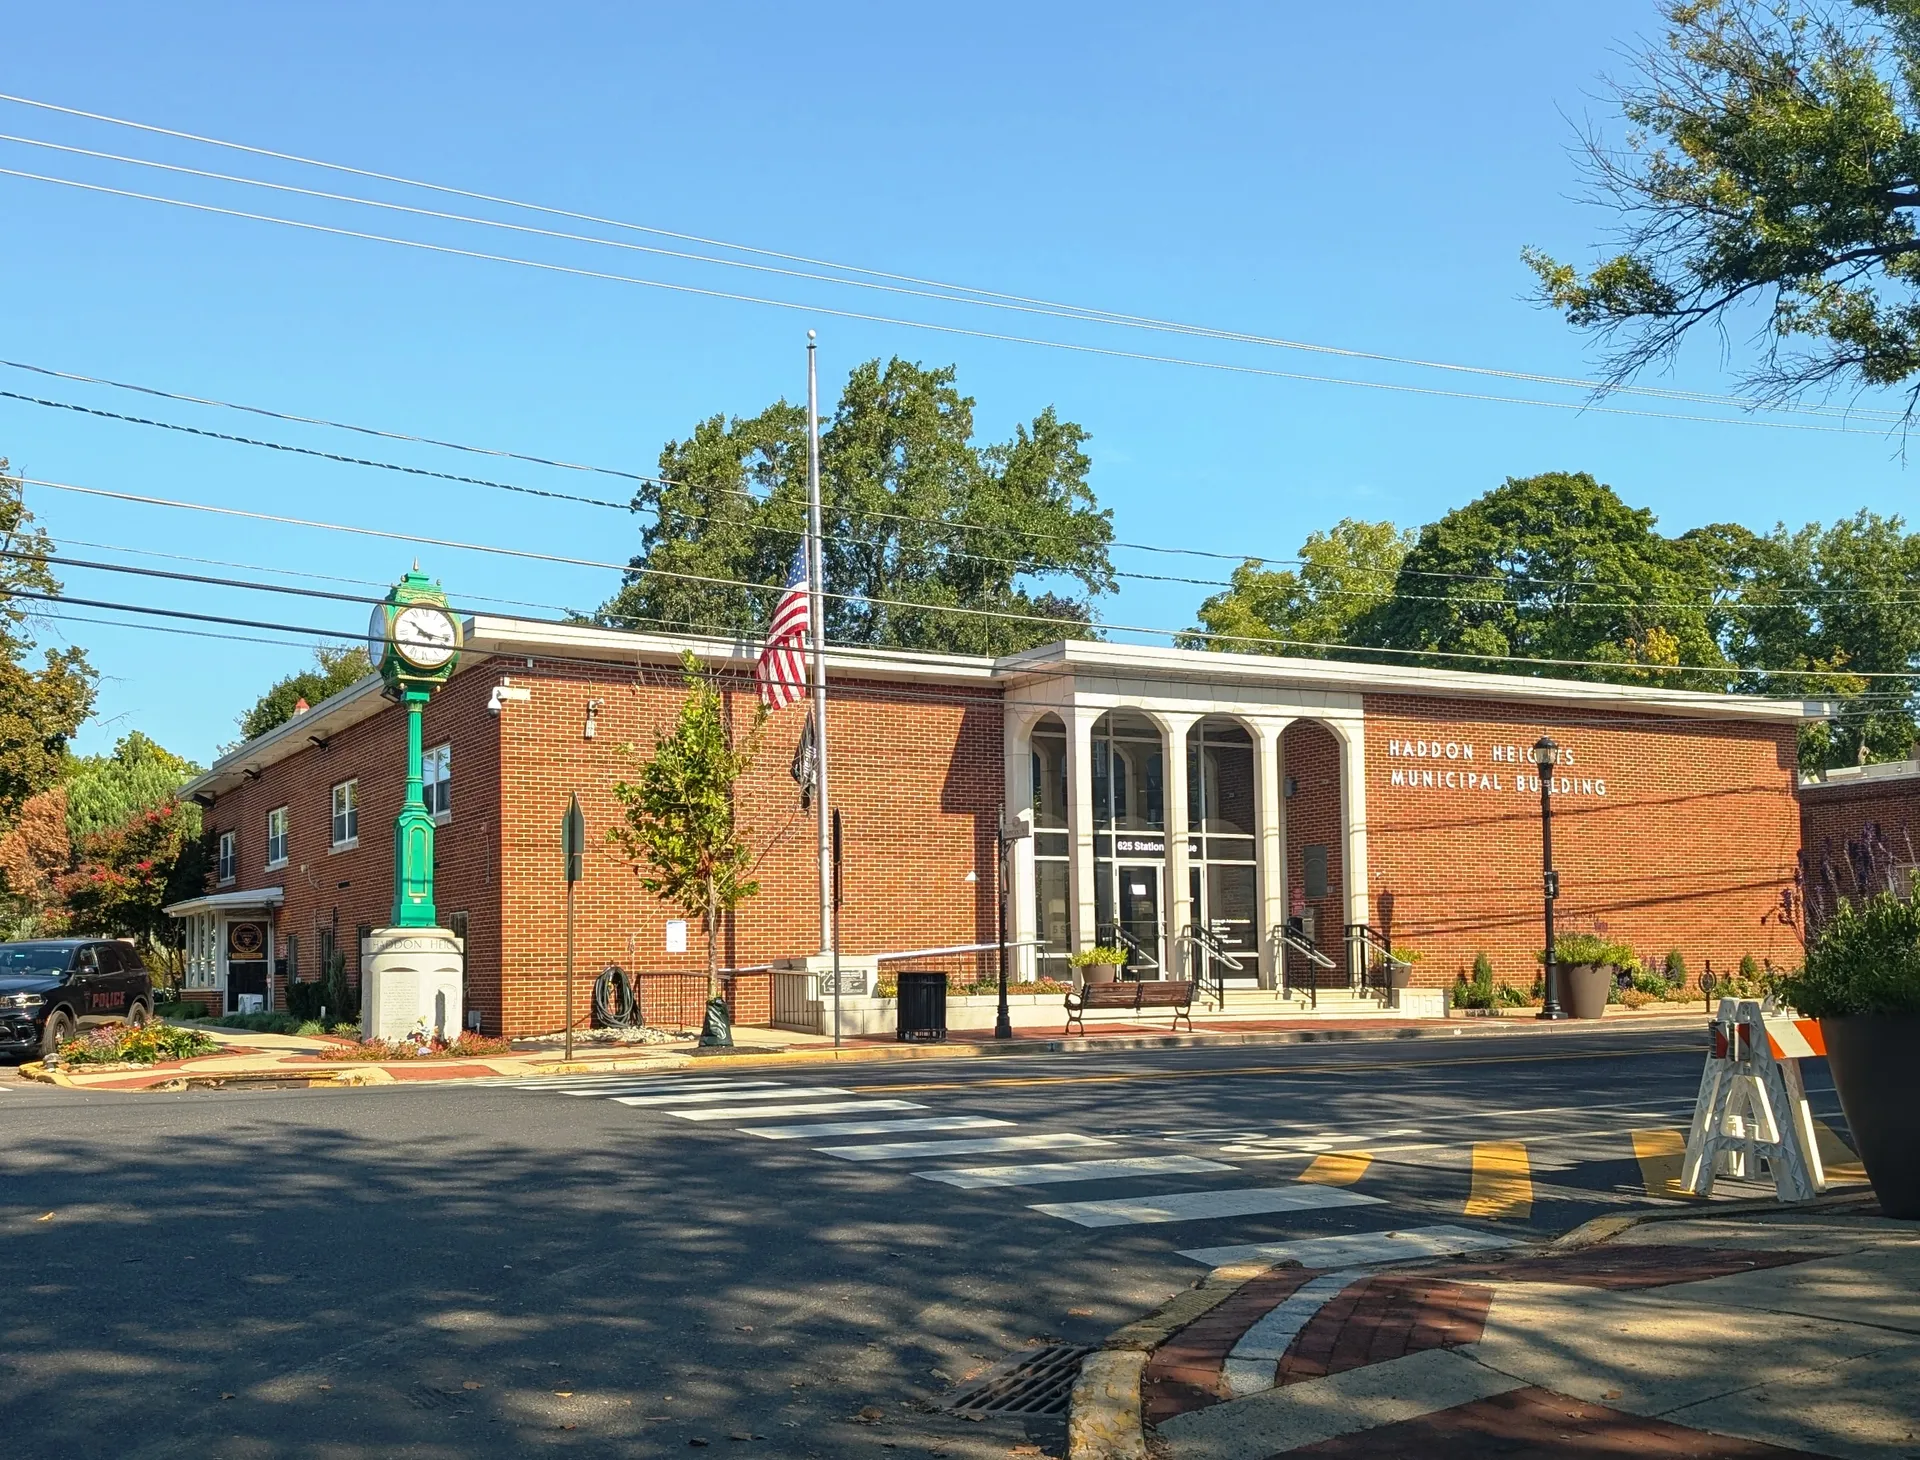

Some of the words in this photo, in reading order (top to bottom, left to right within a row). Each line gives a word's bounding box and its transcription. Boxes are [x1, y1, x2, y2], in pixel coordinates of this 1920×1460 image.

[1389, 740, 1473, 760] HADDON
[1492, 744, 1575, 766] HEIGTS
[1390, 769, 1502, 791] MUNICIPAL
[1516, 775, 1607, 797] BULDING
[1117, 841, 1133, 851] 625
[1134, 841, 1165, 851] Station
[92, 991, 126, 1008] POLICE
